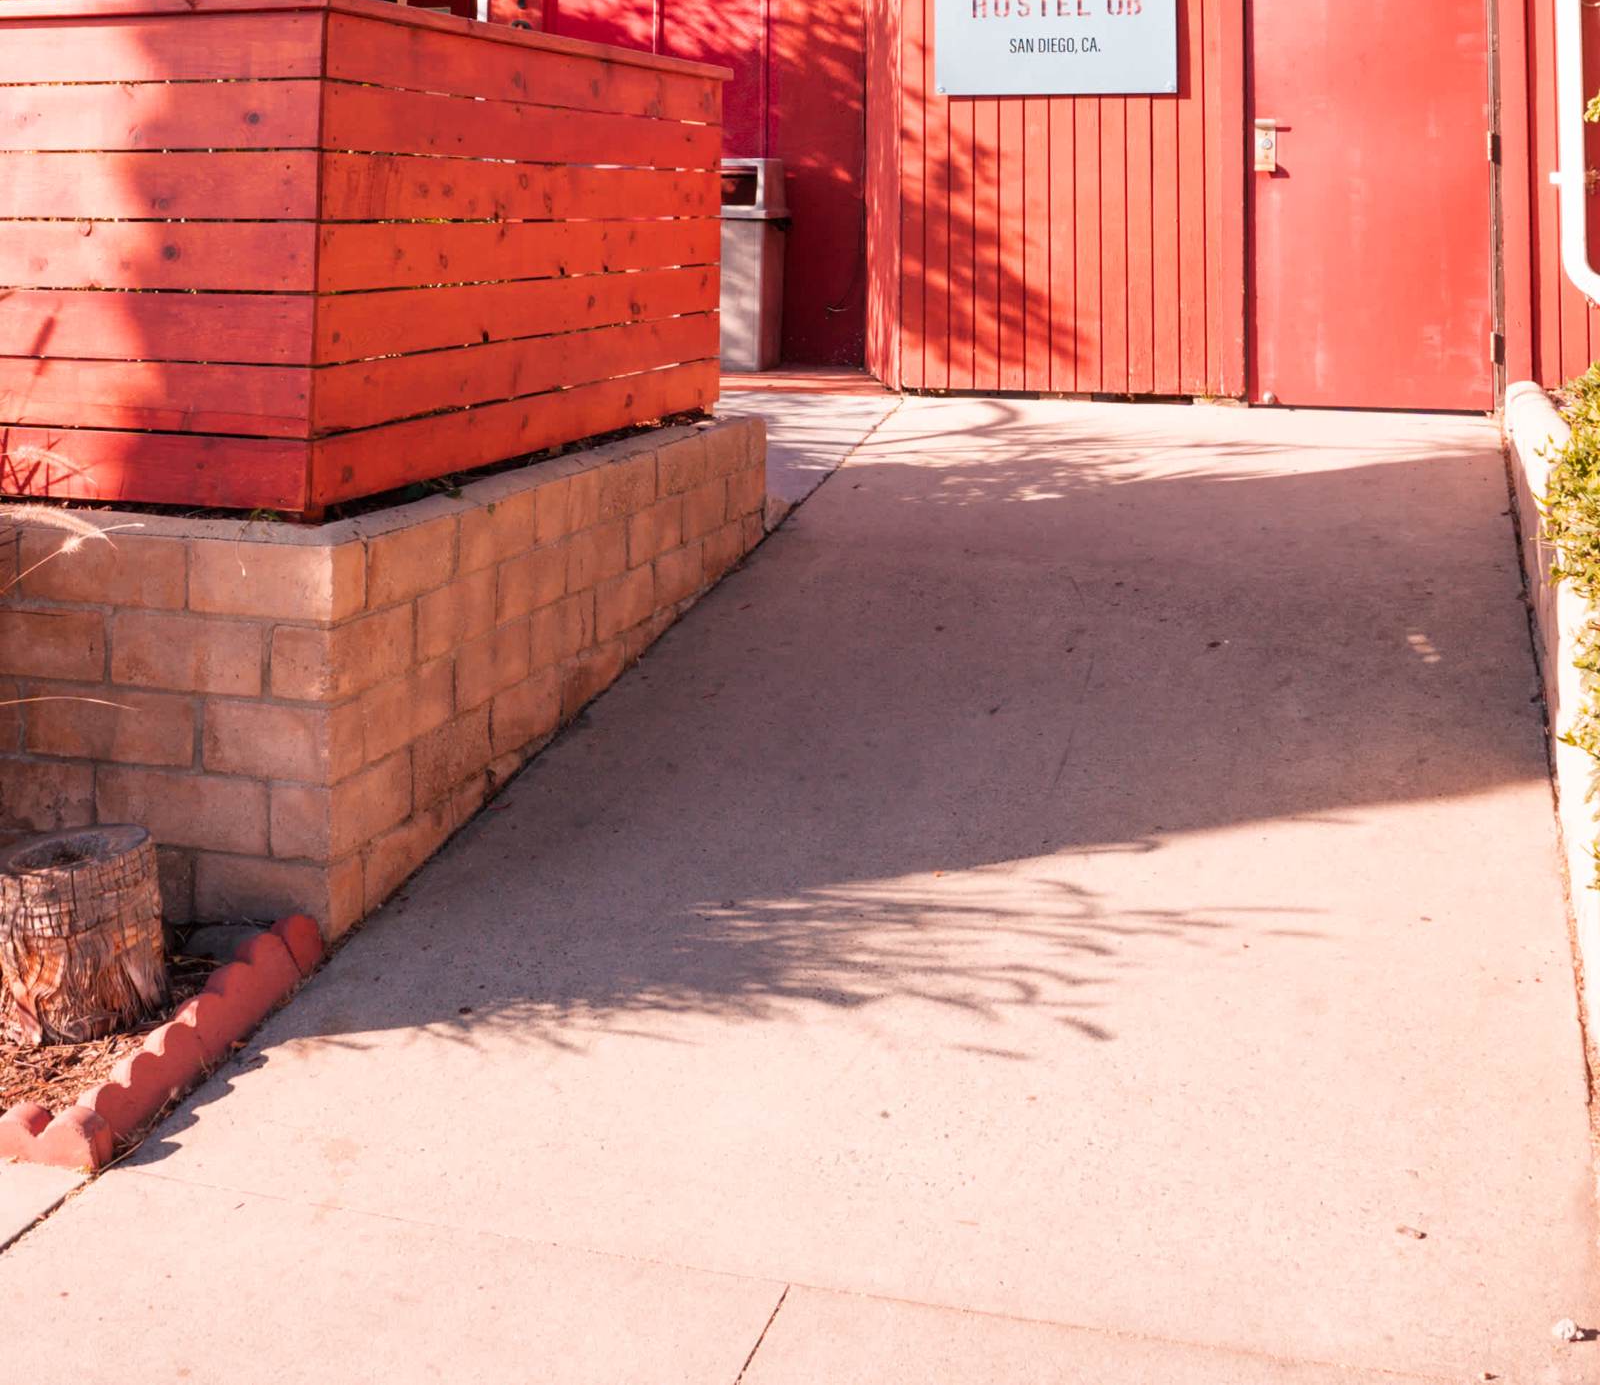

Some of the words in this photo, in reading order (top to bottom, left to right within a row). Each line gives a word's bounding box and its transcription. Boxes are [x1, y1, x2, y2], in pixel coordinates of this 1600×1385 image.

[1009, 37, 1034, 54] SAN
[1038, 37, 1079, 55] DIEGO,
[1081, 36, 1102, 53] CA.
